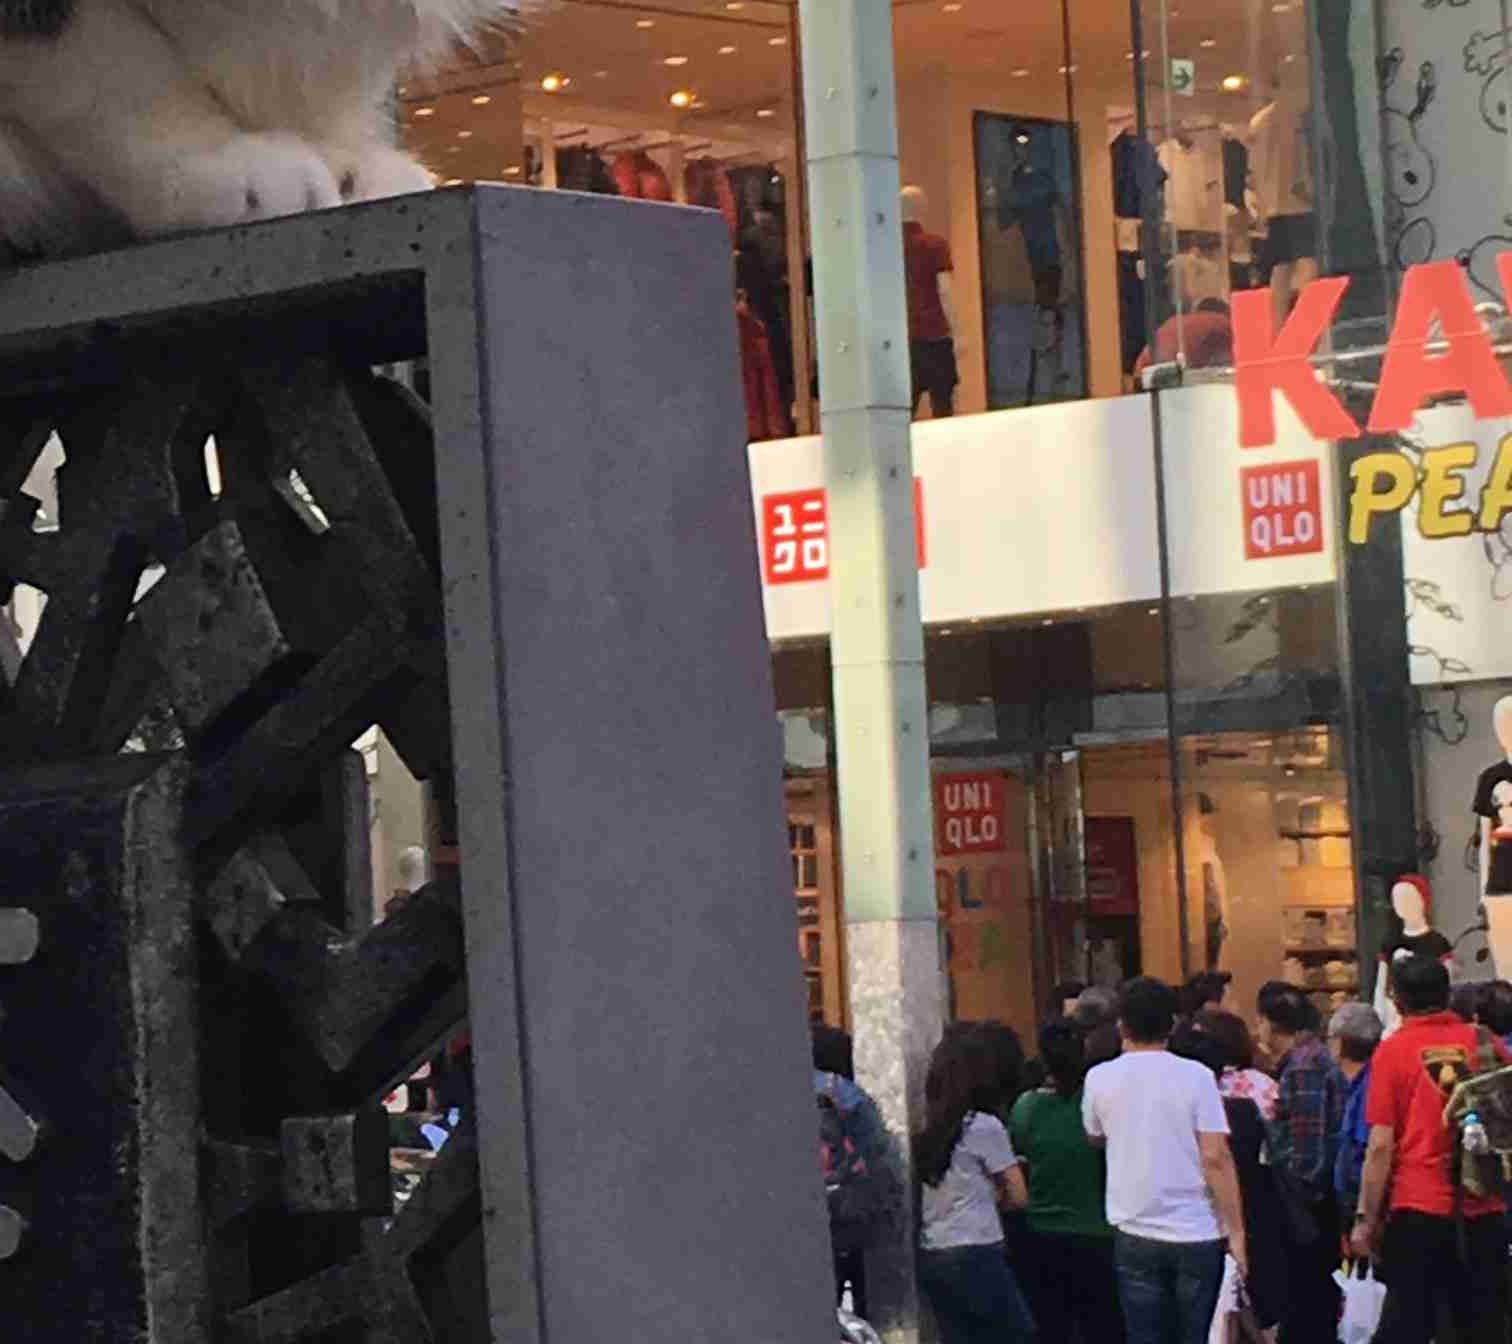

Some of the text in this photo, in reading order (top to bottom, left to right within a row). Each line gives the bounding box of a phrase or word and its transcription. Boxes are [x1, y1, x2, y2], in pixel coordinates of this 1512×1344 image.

[1228, 250, 1512, 449] KA
[1247, 471, 1308, 507] UNI
[1250, 511, 1315, 552] QLO
[943, 782, 993, 811] UNI
[945, 815, 998, 848] QLO
